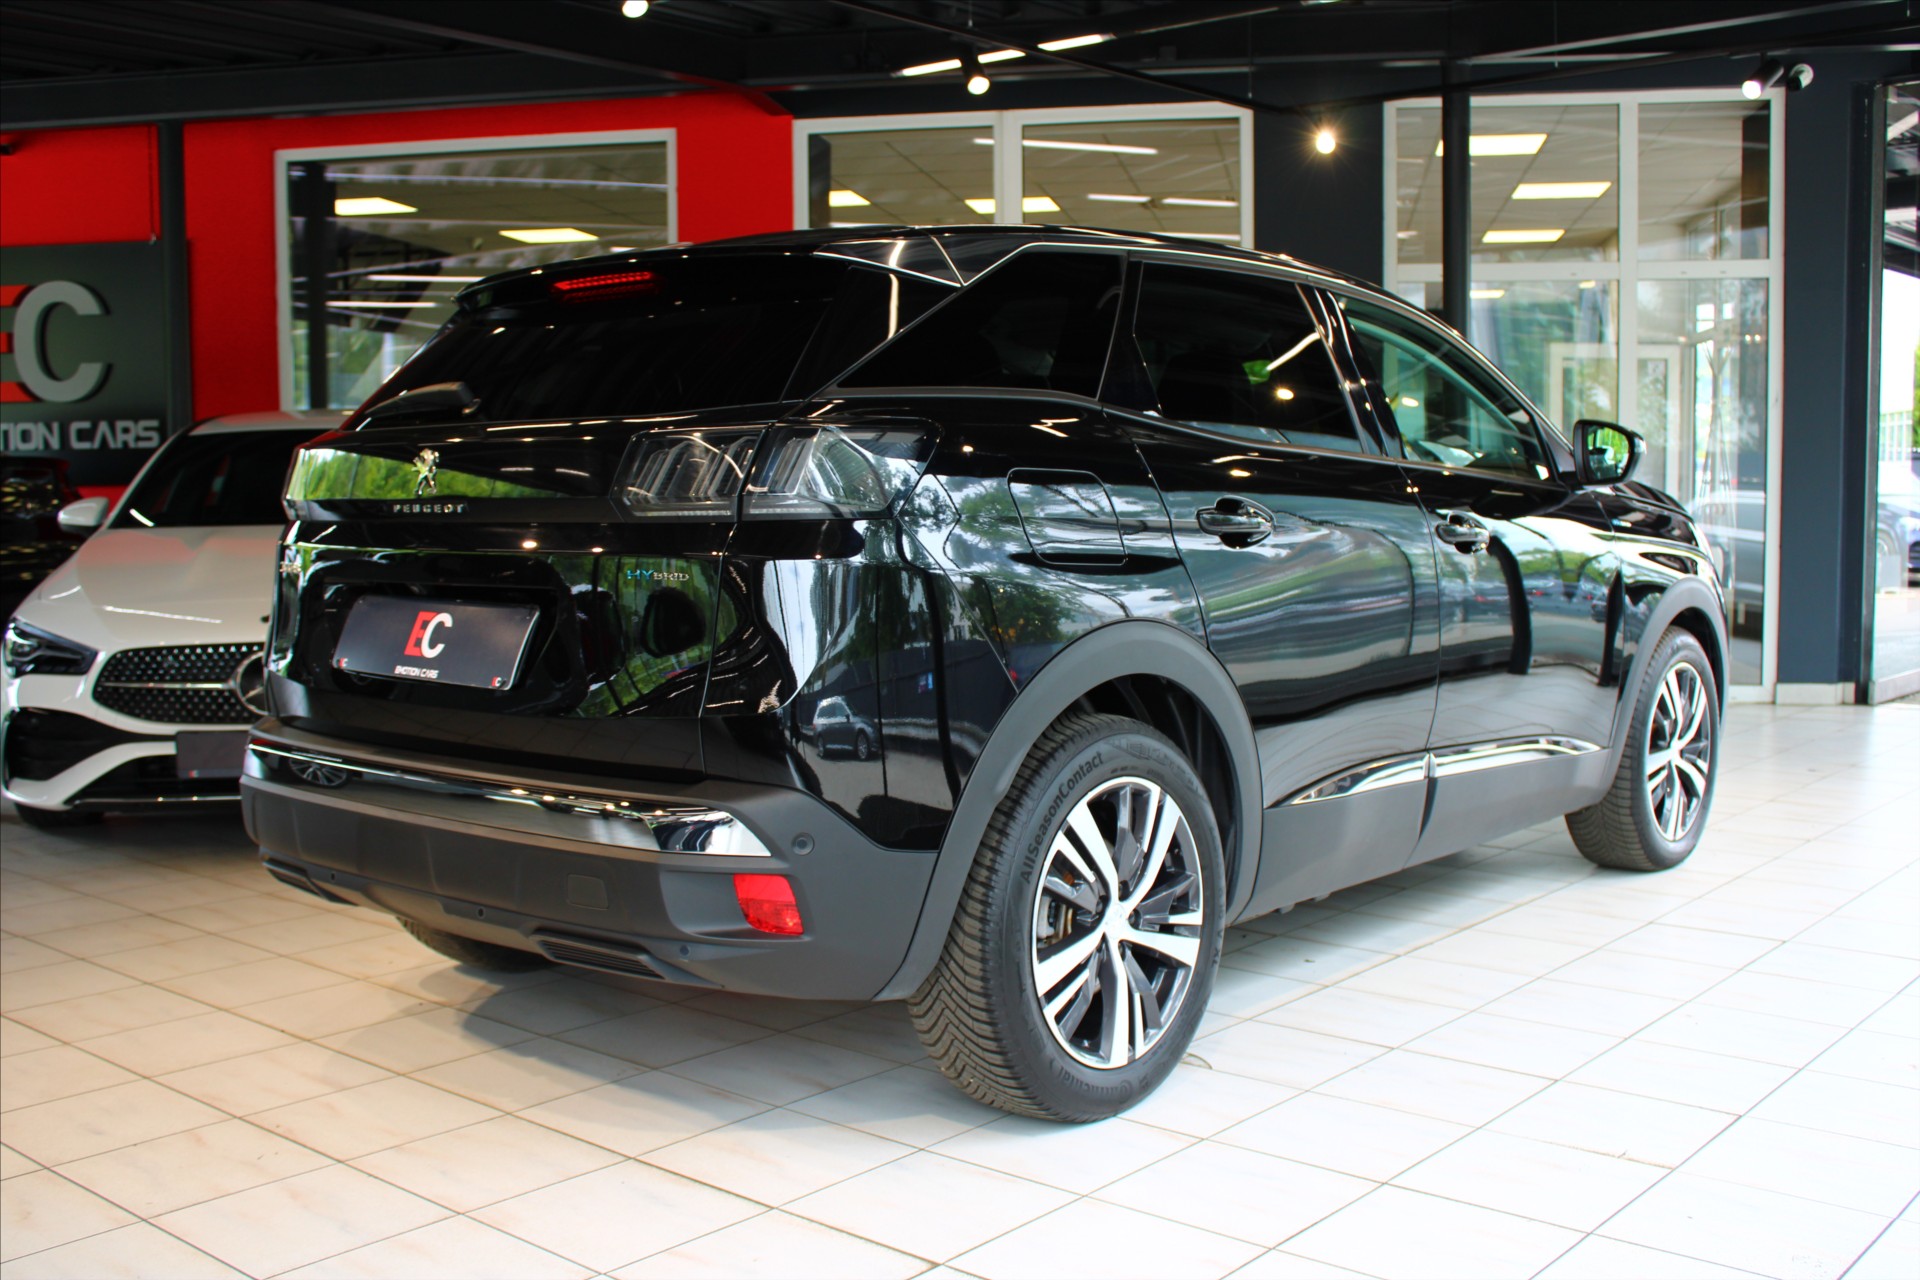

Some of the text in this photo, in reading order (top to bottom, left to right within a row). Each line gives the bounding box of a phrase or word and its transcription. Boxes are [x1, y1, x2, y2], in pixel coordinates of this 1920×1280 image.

[69, 420, 160, 449] CARS
[393, 504, 464, 513] PEUGEOT
[627, 569, 689, 581] HYBRID
[404, 611, 453, 658] EC
[1020, 750, 1104, 884] AllSeasonContact
